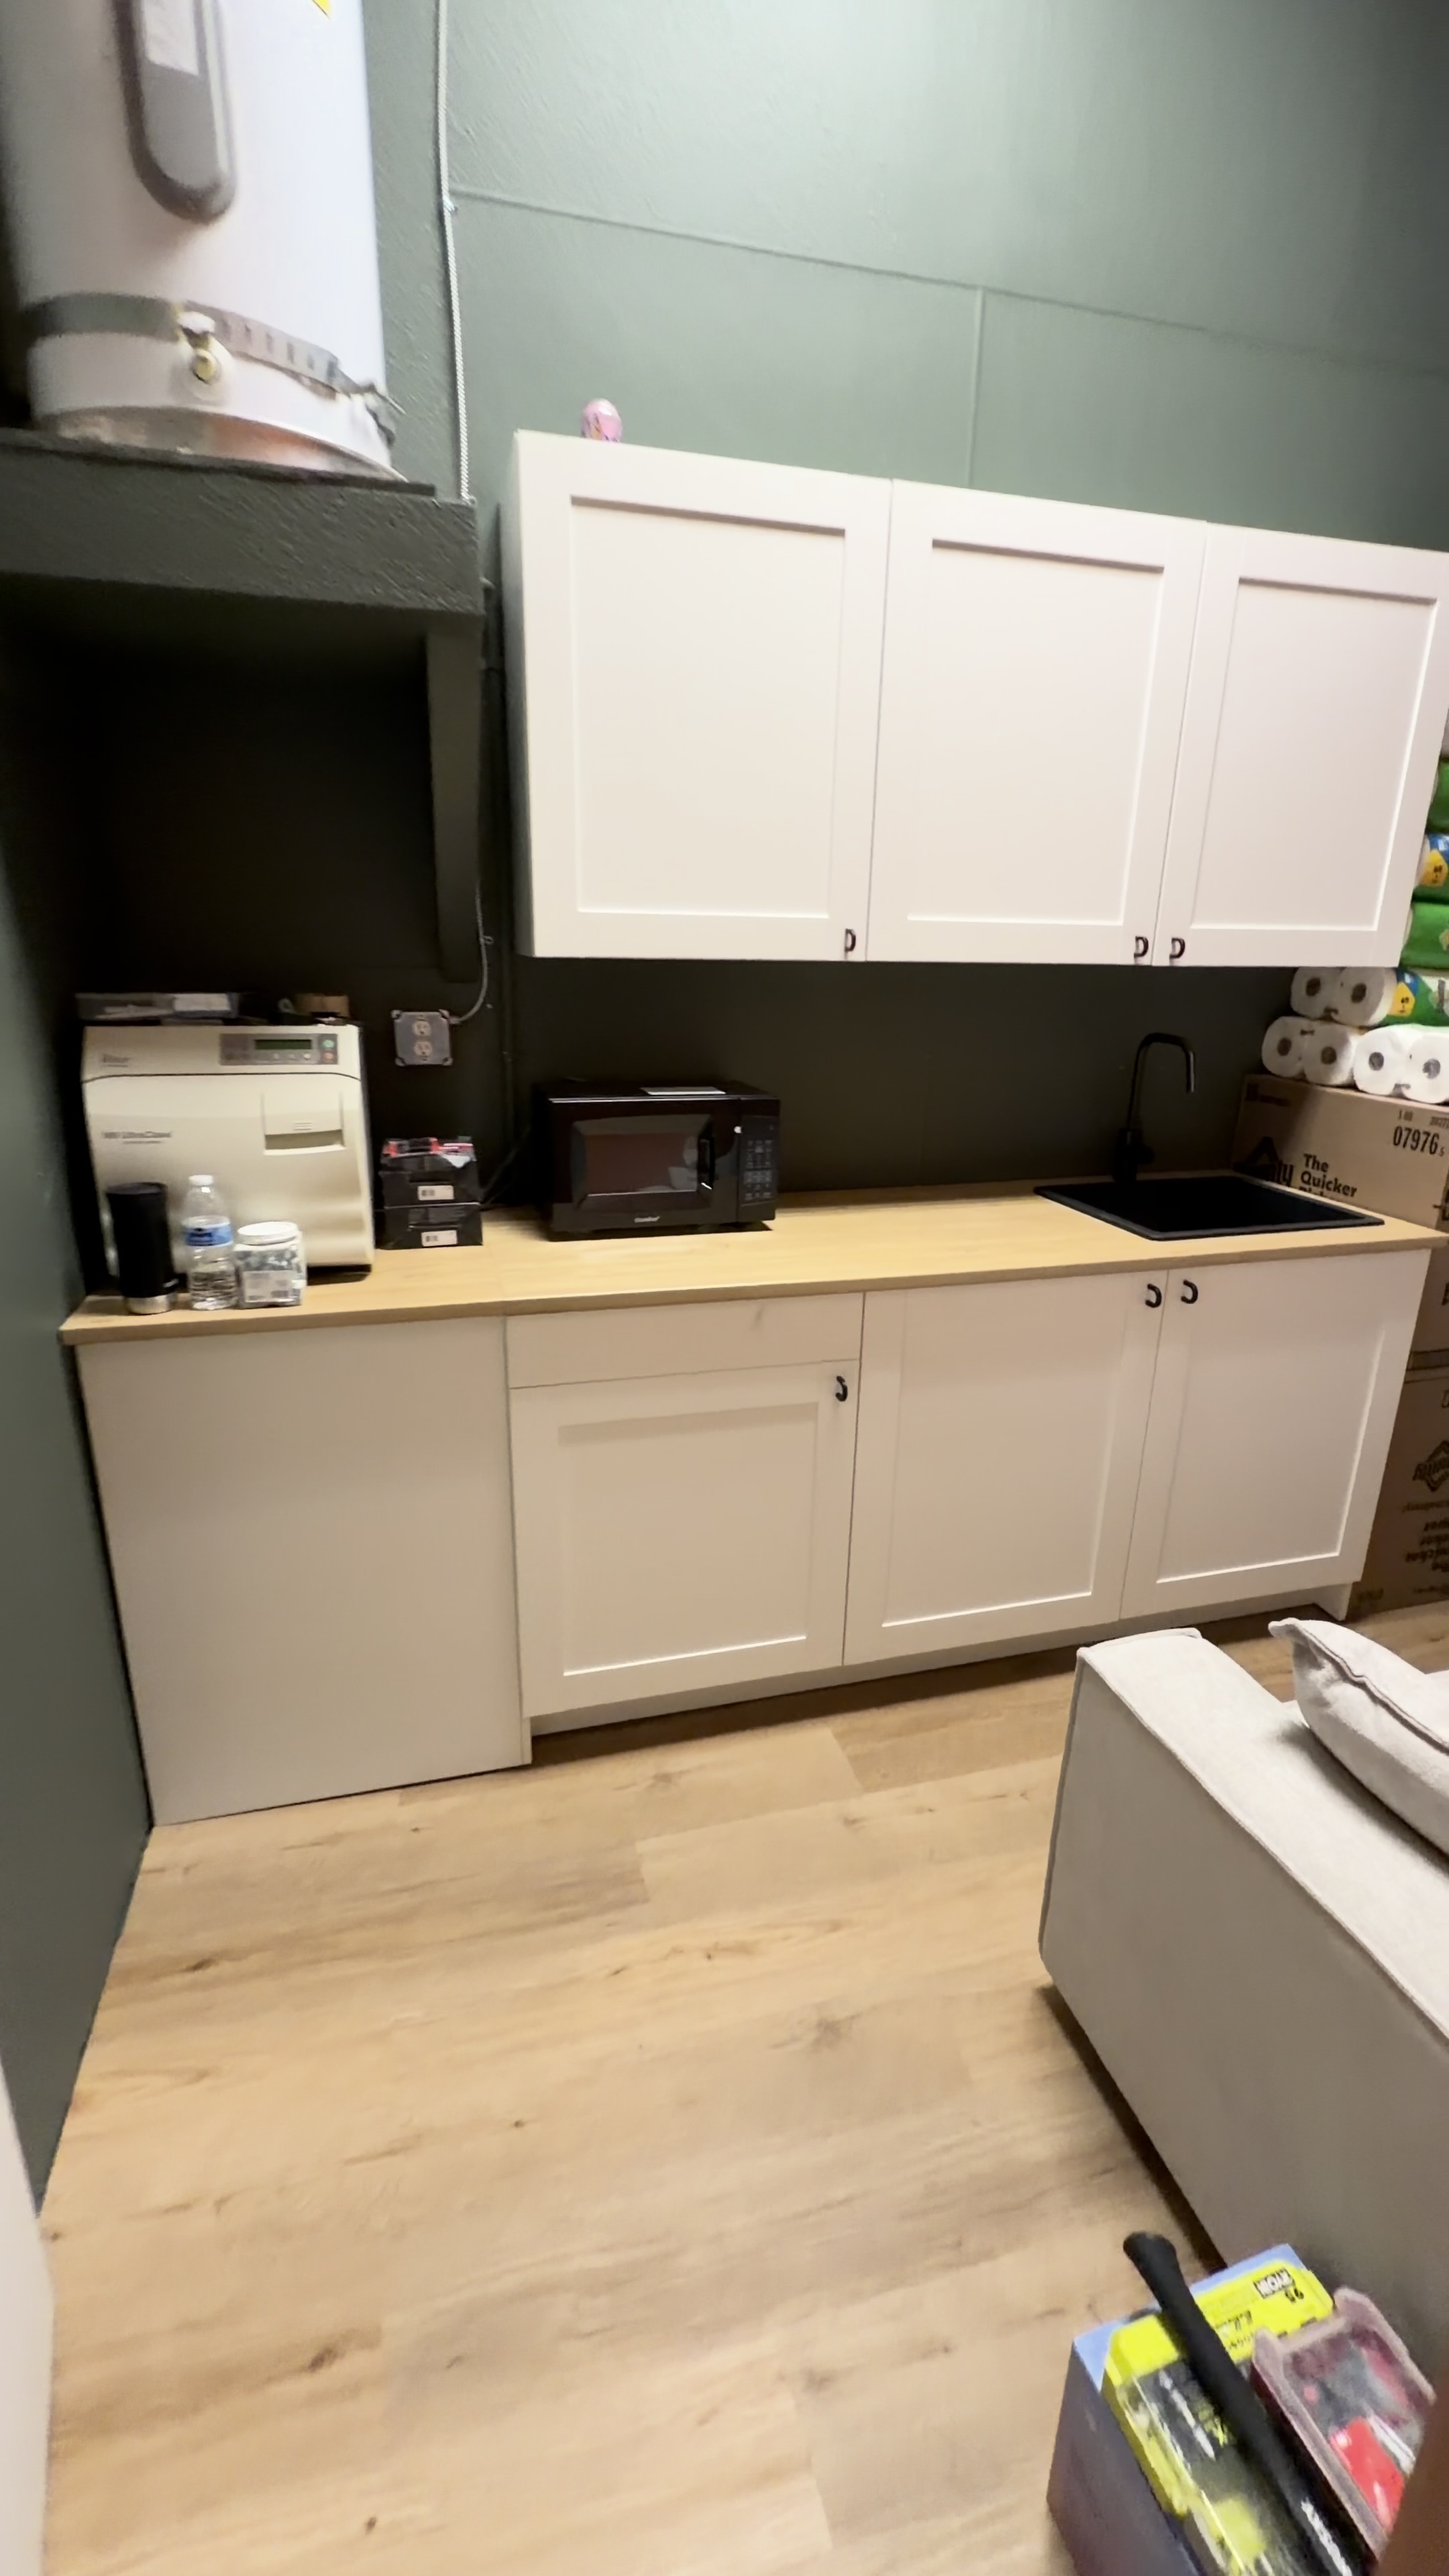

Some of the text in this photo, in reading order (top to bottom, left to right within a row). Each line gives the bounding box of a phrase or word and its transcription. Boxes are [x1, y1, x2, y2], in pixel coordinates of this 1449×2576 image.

[1393, 1126, 1440, 1155] 07976
[1303, 1152, 1329, 1173] The
[1301, 1171, 1358, 1197] Quicker
